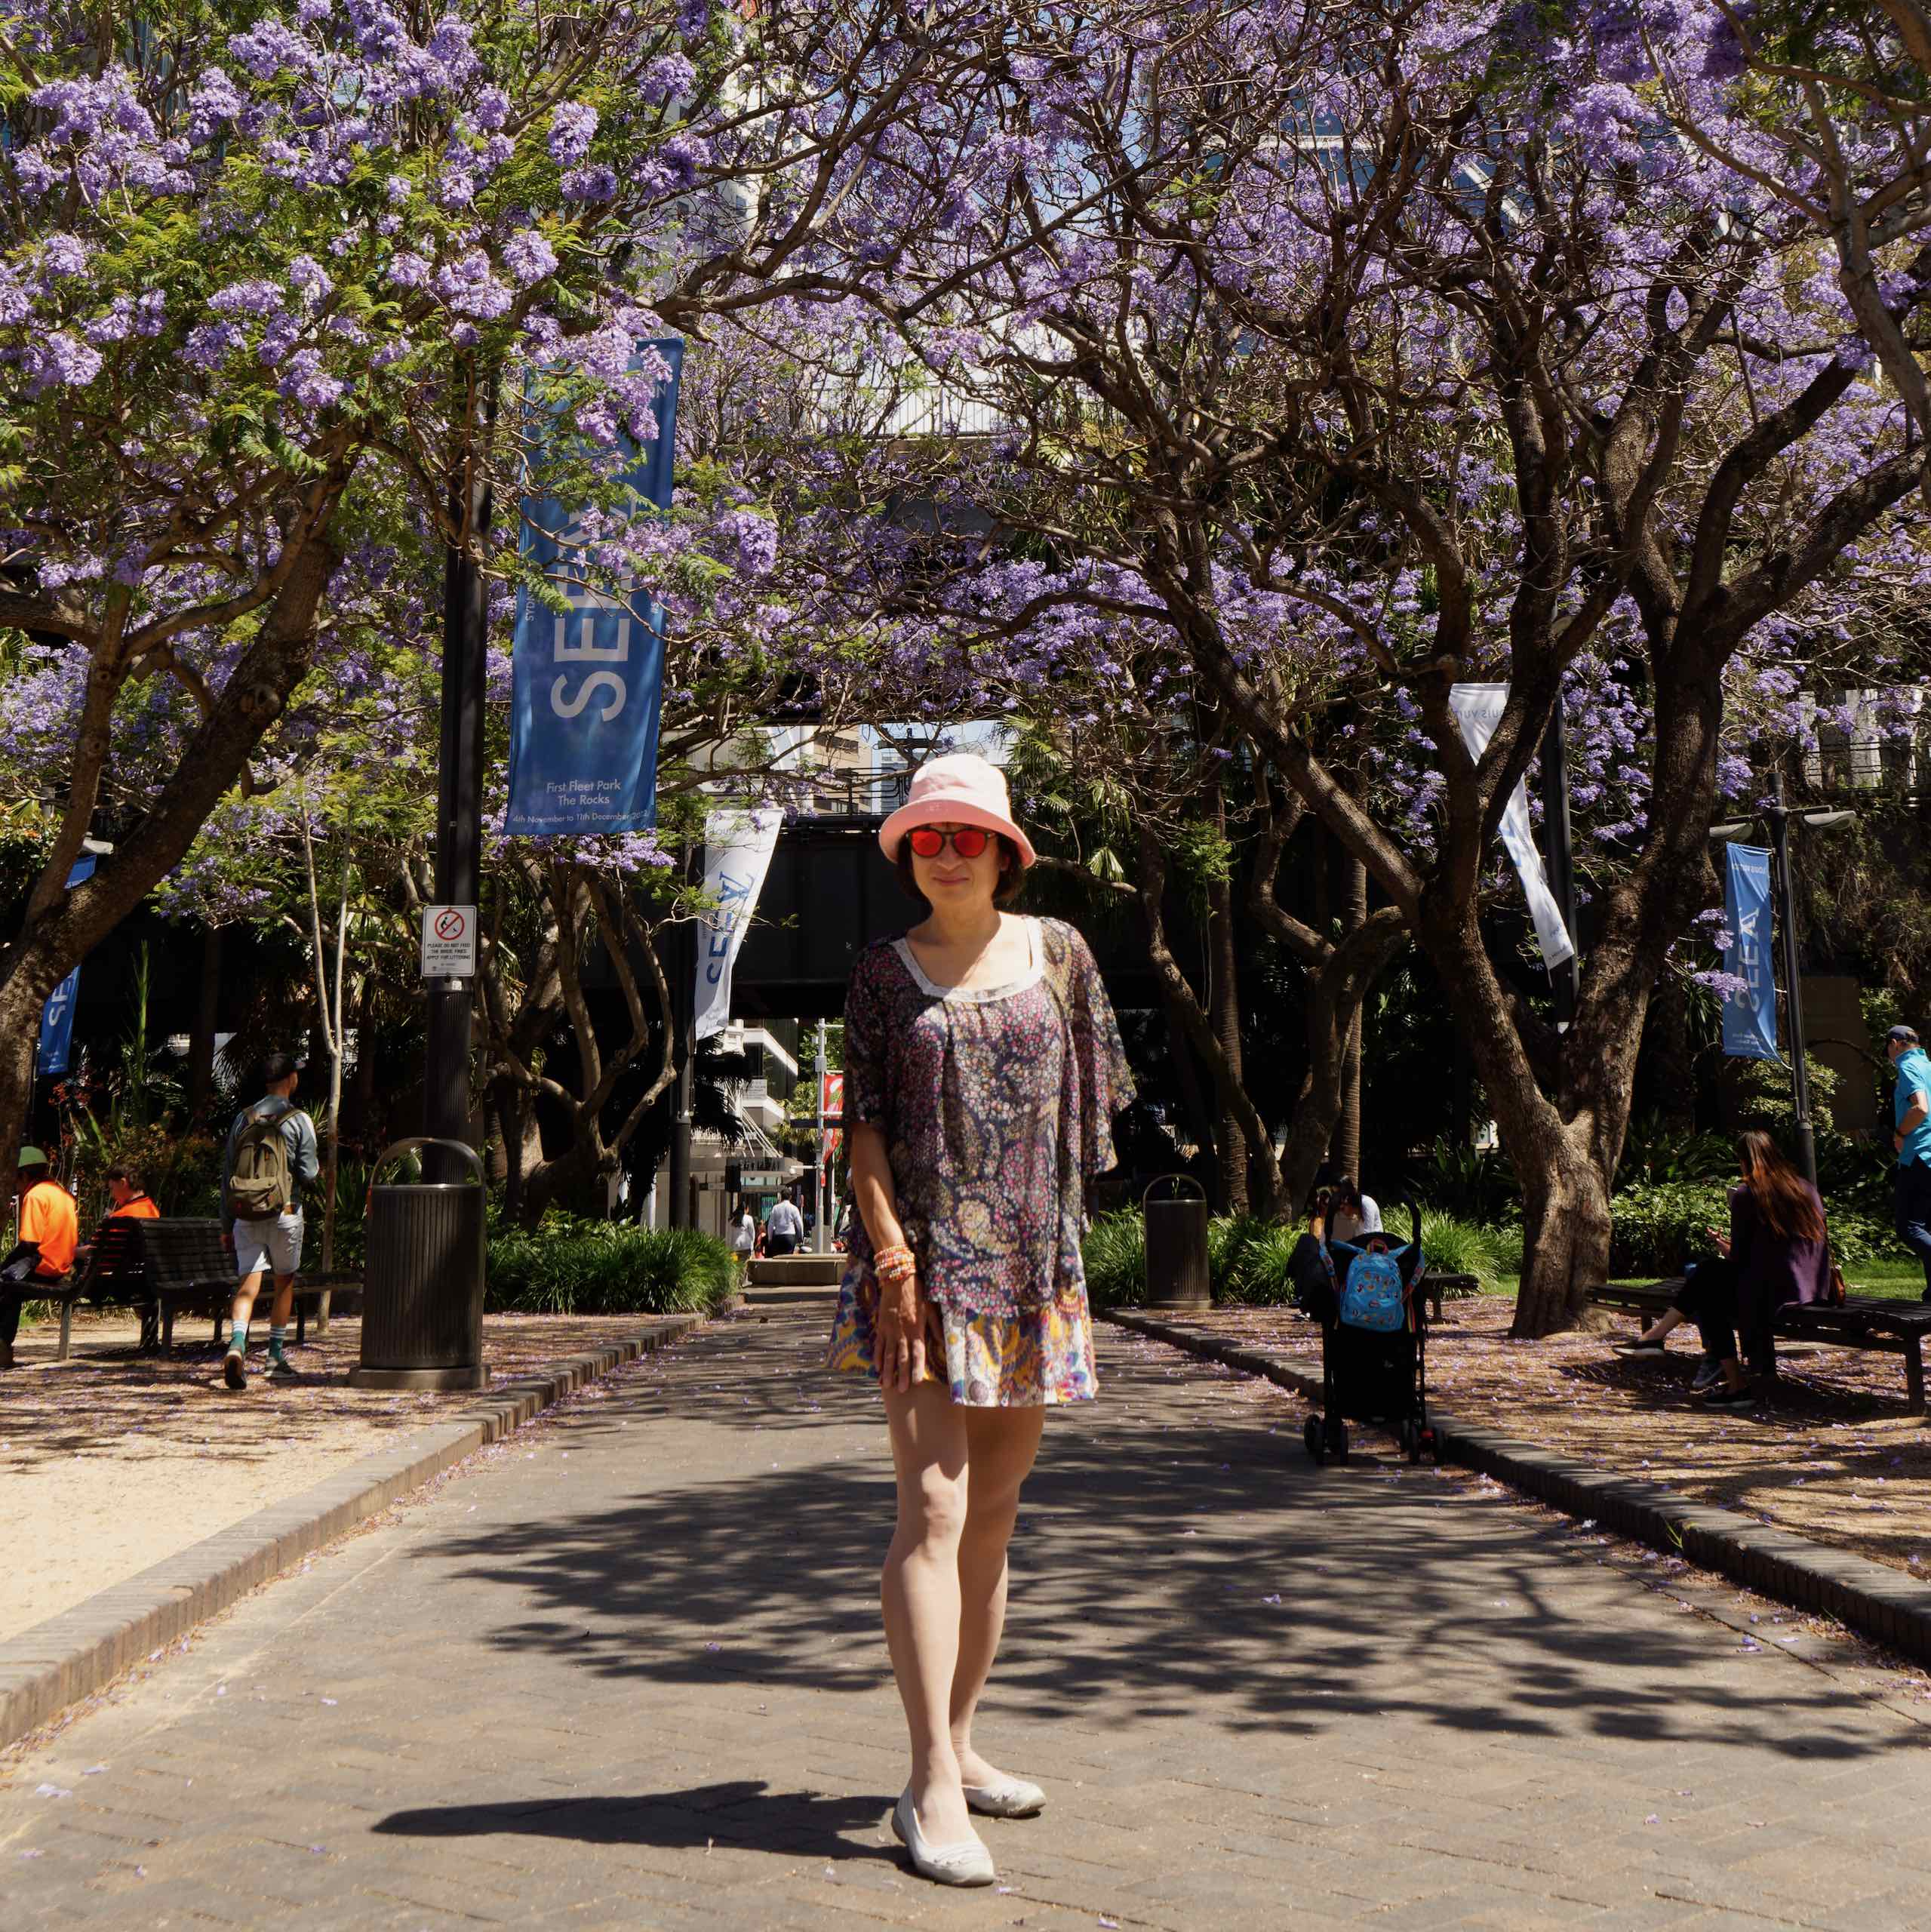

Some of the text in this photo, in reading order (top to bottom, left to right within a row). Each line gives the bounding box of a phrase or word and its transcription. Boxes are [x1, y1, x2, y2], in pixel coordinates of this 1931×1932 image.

[546, 778, 621, 792] First Fleet Park
[558, 794, 610, 806] The Rocks
[527, 814, 565, 823] November
[592, 812, 629, 821] December
